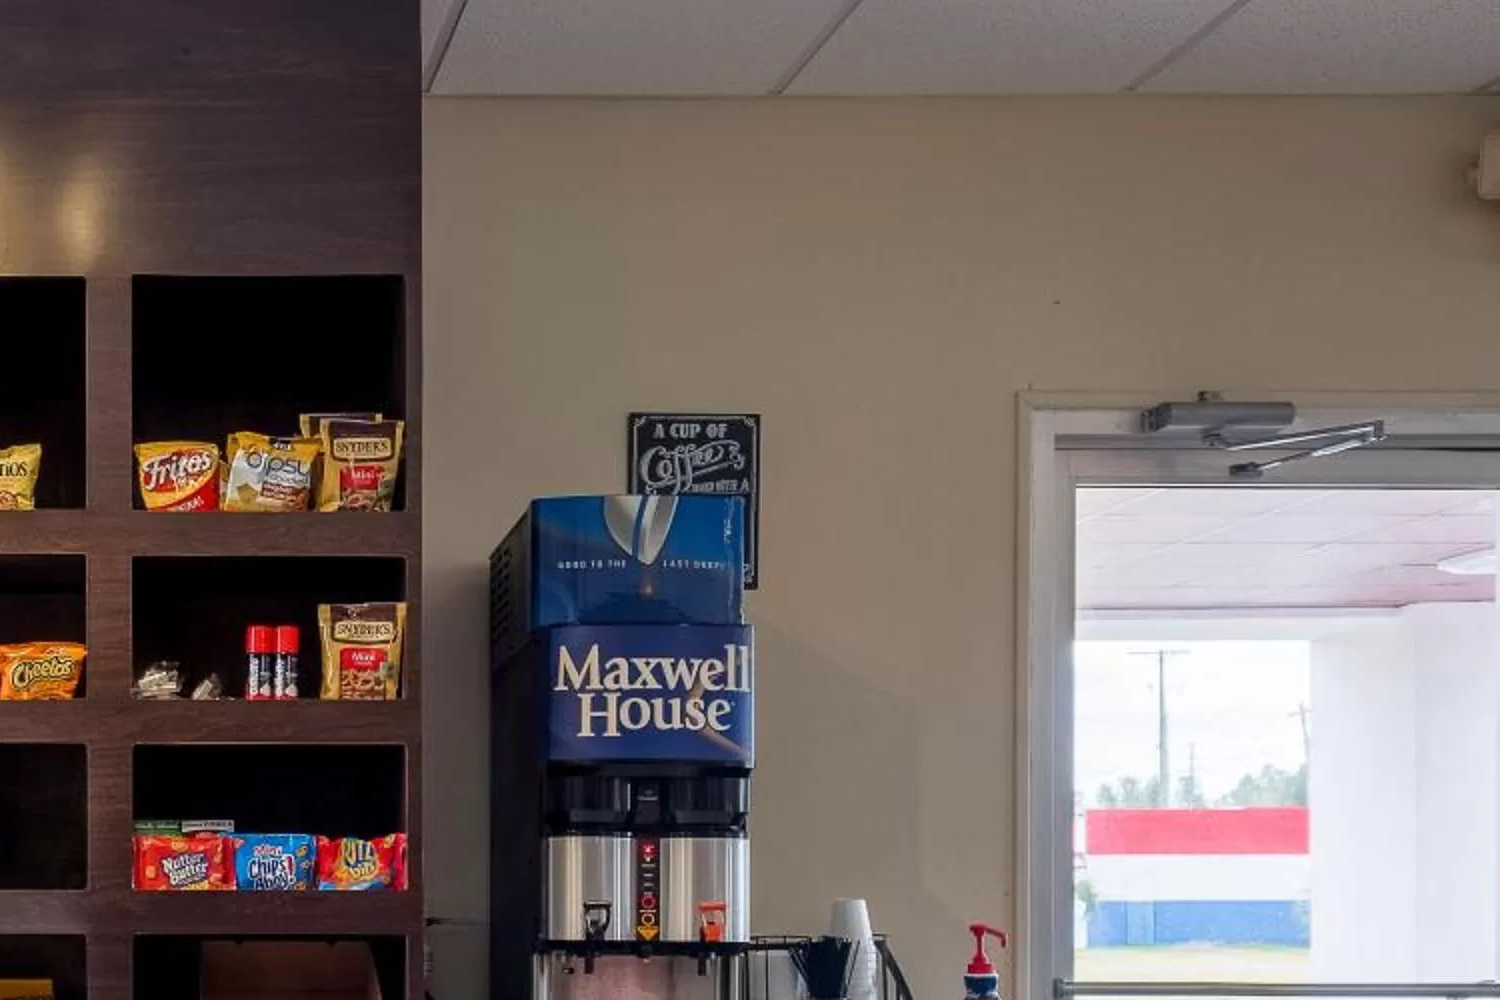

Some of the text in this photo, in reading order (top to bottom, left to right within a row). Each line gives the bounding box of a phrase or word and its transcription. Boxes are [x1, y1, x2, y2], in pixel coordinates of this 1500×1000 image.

[652, 423, 728, 439] A CUP OF
[141, 451, 212, 491] Fritos
[641, 439, 741, 495] Coffee
[11, 657, 74, 691] Cheetos
[553, 643, 751, 692] Maxwell
[576, 692, 732, 738] House
[161, 852, 206, 873] Nutter
